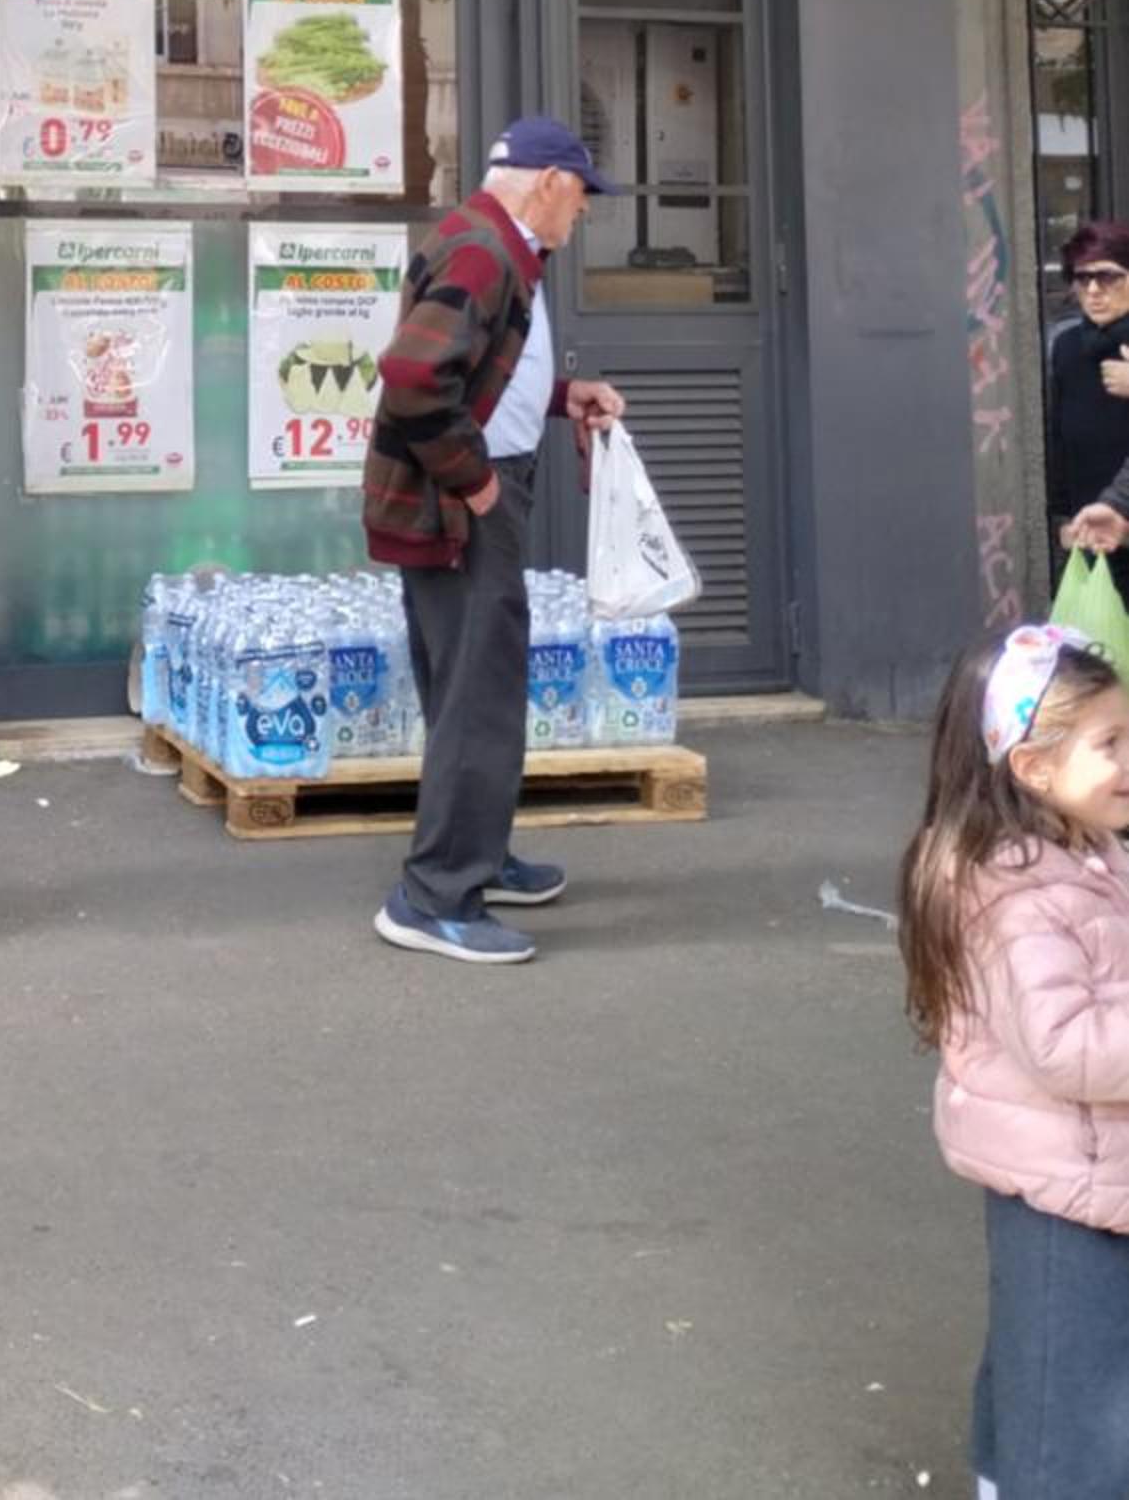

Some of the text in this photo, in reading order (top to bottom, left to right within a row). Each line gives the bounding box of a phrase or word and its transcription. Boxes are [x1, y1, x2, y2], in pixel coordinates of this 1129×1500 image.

[78, 242, 160, 262] Ipercarni
[298, 243, 376, 262] Ipercarni
[334, 651, 376, 668] ANTA
[615, 641, 665, 660] SANTA
[256, 708, 306, 736] eva
